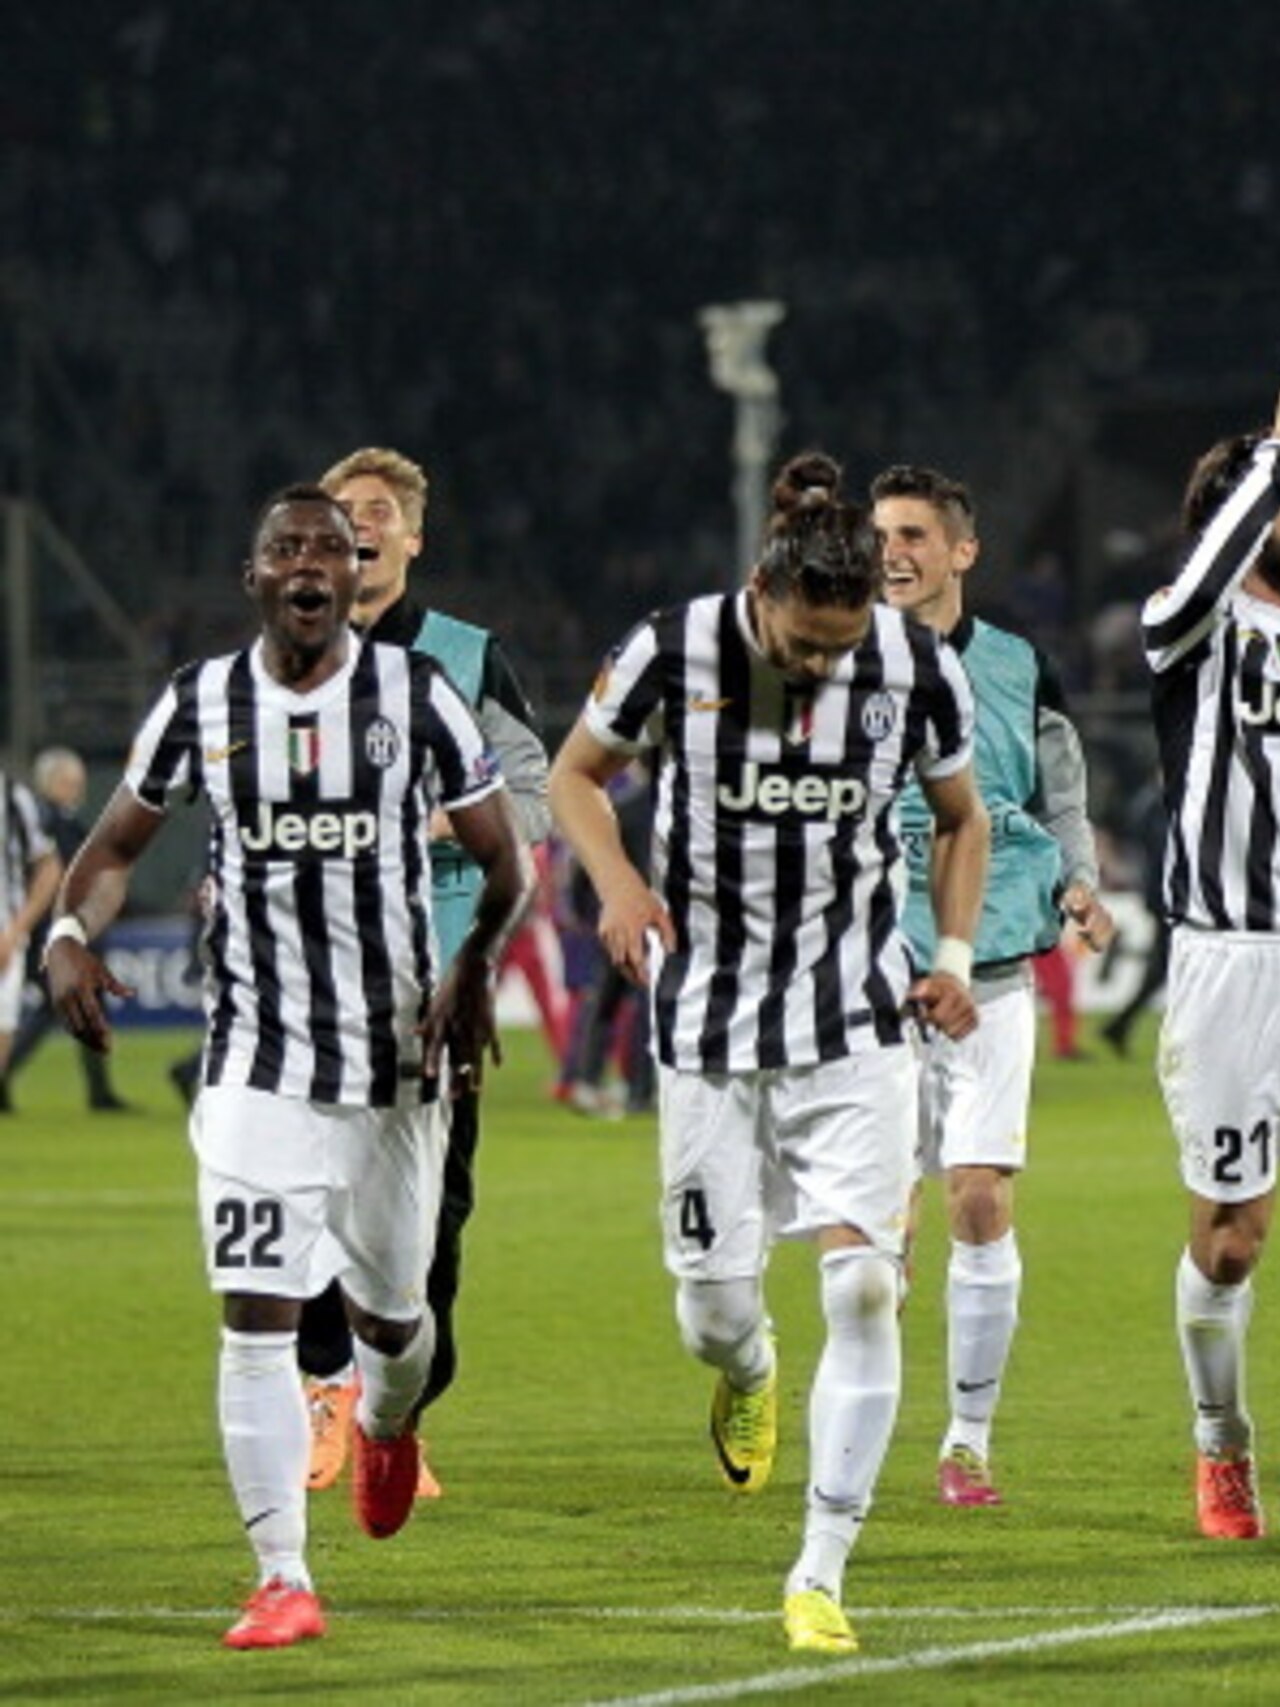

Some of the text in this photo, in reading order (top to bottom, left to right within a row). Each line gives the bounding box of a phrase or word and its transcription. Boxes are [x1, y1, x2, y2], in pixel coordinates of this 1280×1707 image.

[718, 761, 867, 822] Jeep
[240, 801, 376, 859] Jeep
[1214, 1119, 1269, 1184] 21
[214, 1199, 283, 1268] 22
[680, 1188, 716, 1252] 4
